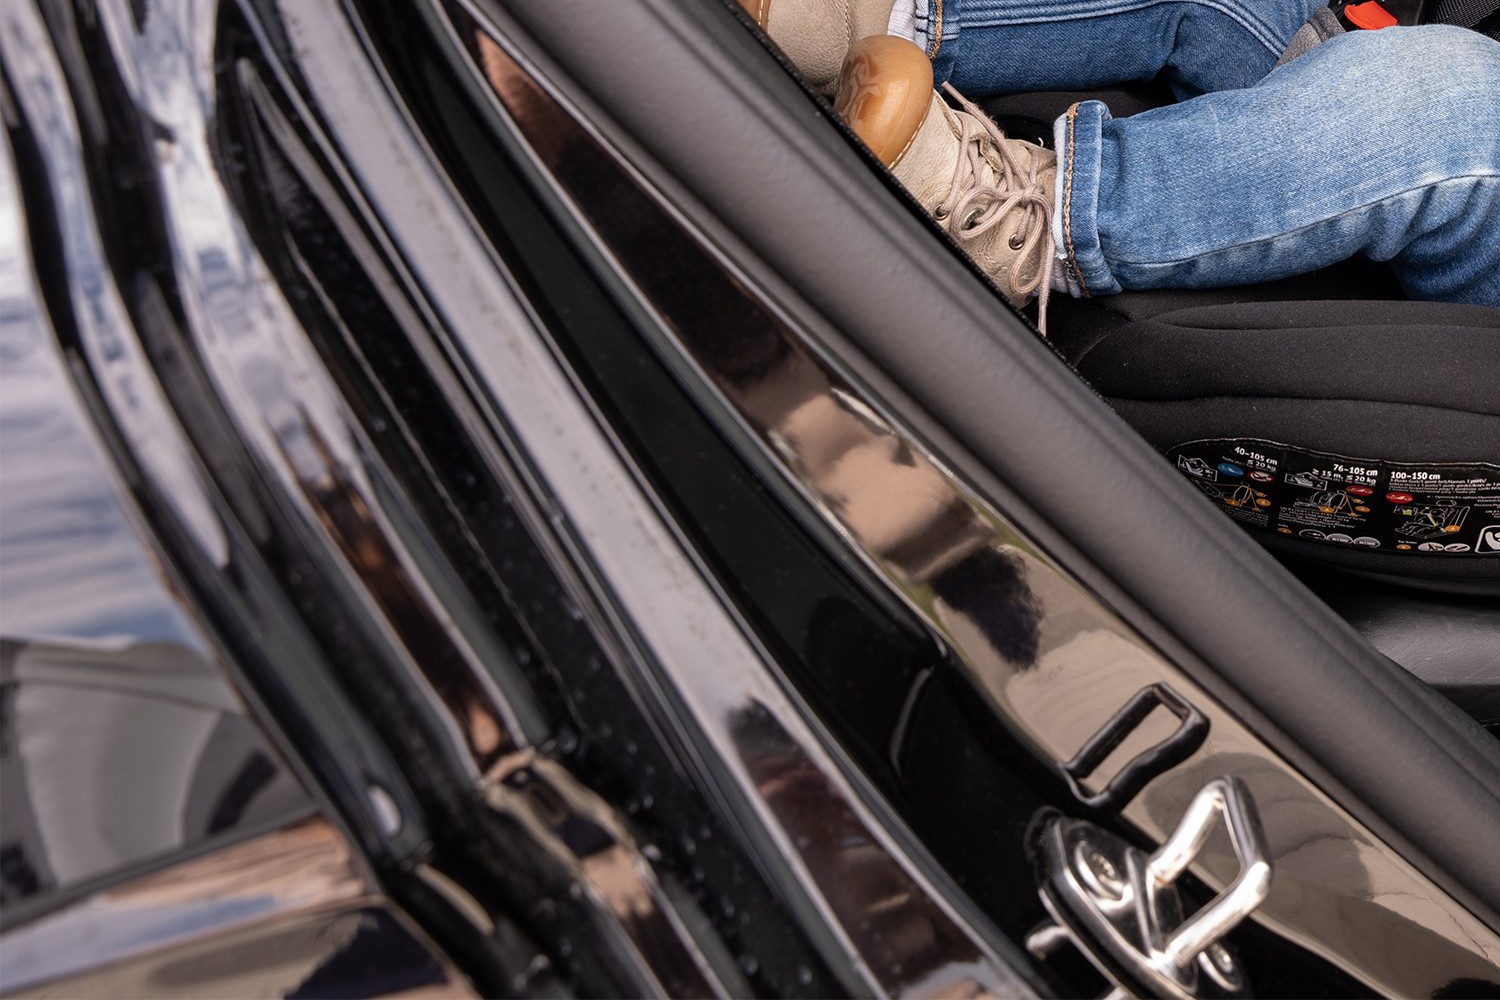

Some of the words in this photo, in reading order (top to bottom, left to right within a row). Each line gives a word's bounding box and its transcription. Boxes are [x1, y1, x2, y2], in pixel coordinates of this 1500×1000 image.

[1234, 446, 1265, 462] 40-105
[1265, 457, 1278, 466] cm
[1255, 460, 1266, 468] 20
[1333, 463, 1365, 476] 76-105
[1365, 469, 1378, 477] cm
[1390, 470, 1428, 480] 100-150
[1428, 473, 1441, 481] cm
[1354, 475, 1366, 483] 20
[1366, 477, 1377, 485] kg
